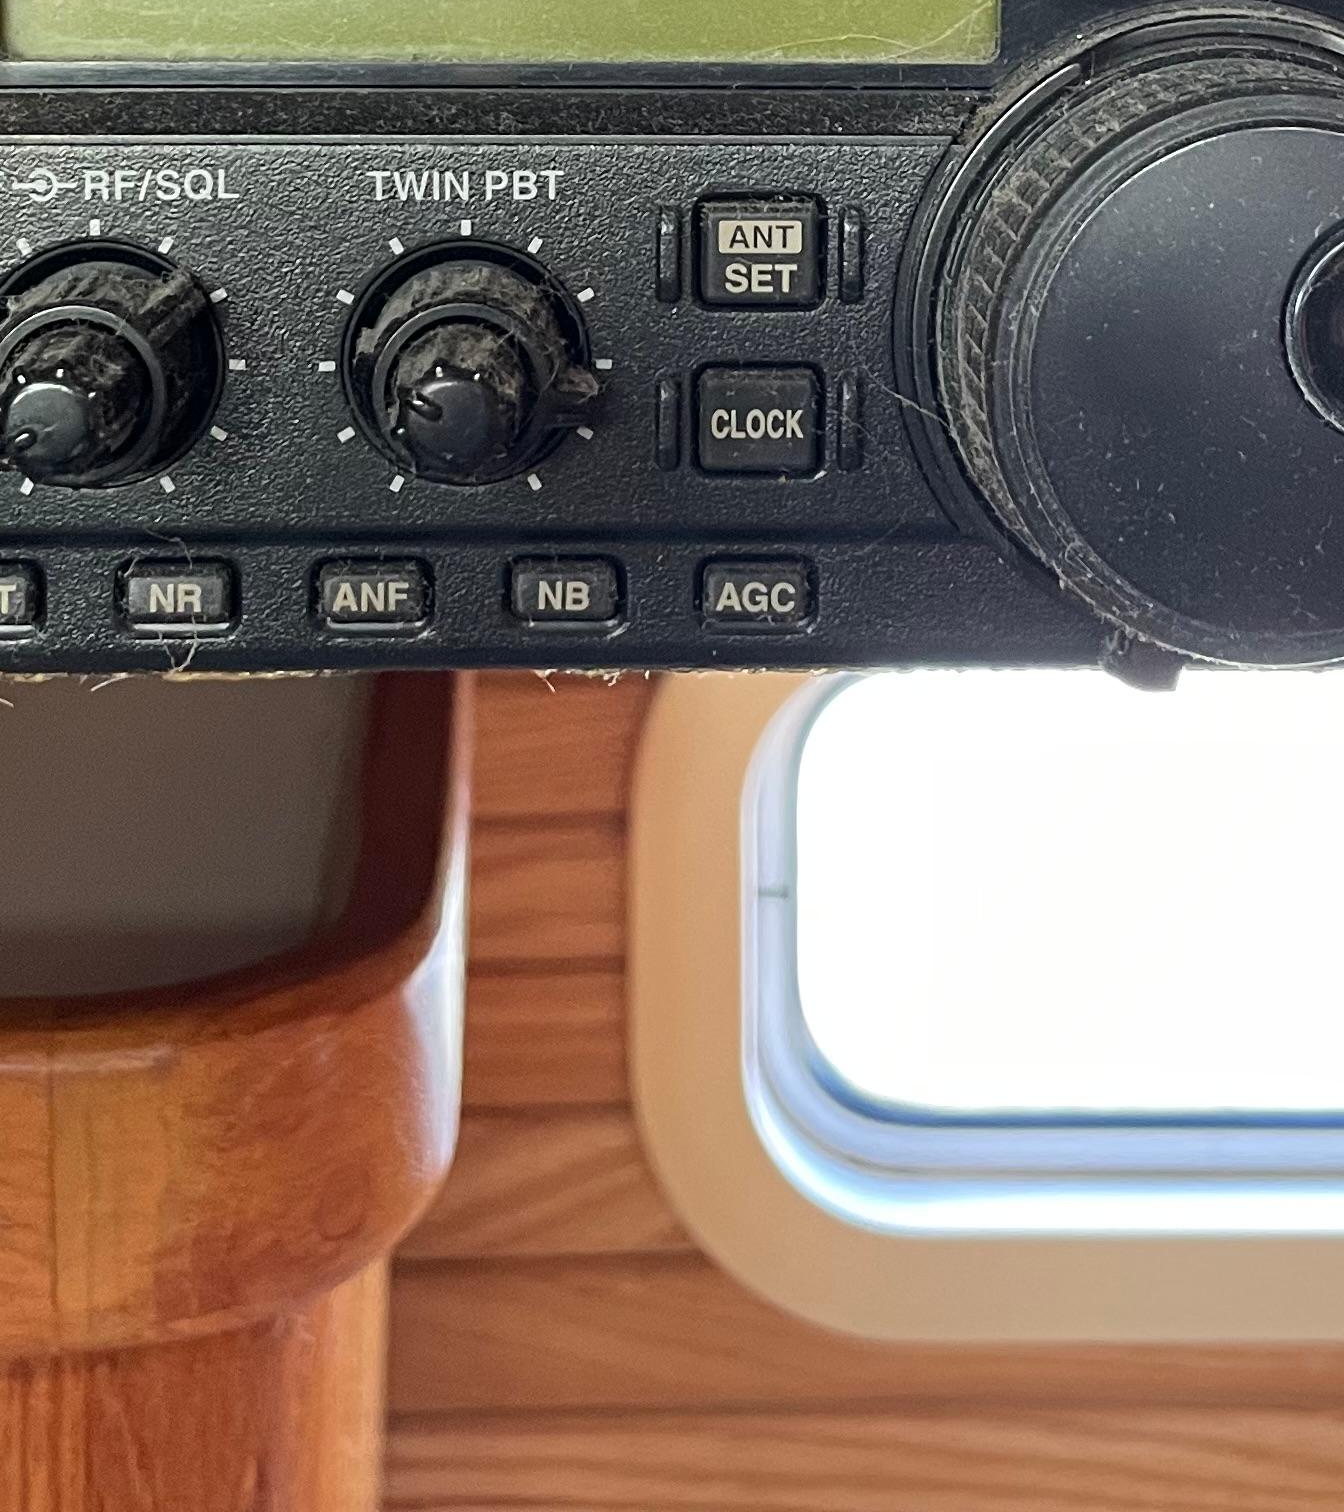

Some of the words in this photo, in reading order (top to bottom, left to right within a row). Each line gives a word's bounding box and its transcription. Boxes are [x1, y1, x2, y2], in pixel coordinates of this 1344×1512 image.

[83, 168, 240, 203] RF/SQL
[366, 170, 464, 202] TWIN
[484, 169, 566, 201] PBT
[729, 222, 794, 249] ANT
[723, 262, 798, 294] SET
[709, 408, 805, 442] CLOCK
[149, 583, 203, 614] NR
[331, 581, 410, 613] ANF
[537, 580, 591, 612] NB
[715, 581, 797, 613] AGC
